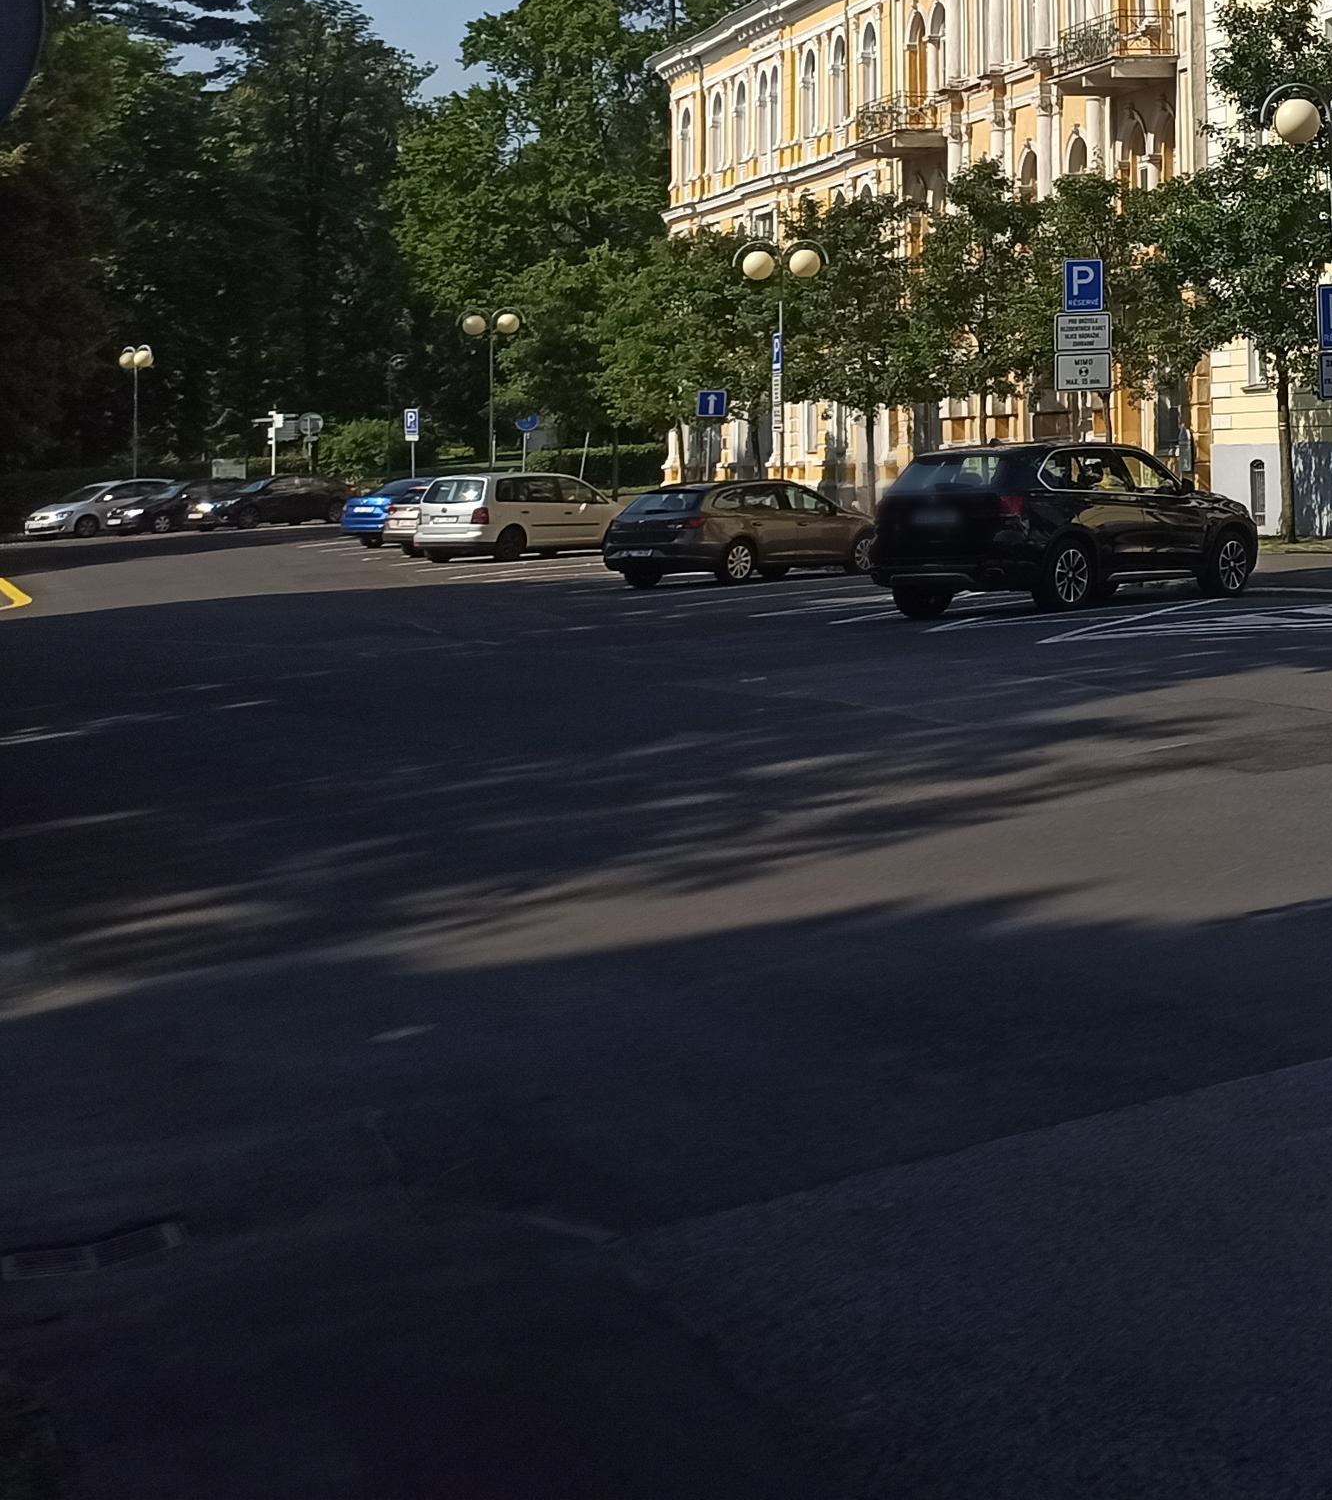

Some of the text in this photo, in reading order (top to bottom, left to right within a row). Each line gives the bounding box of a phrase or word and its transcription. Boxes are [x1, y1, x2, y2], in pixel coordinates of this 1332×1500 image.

[1072, 265, 1095, 296] P
[1068, 298, 1099, 307] RÉSERVÉ
[1074, 358, 1094, 366] MIMO
[407, 412, 416, 427] P
